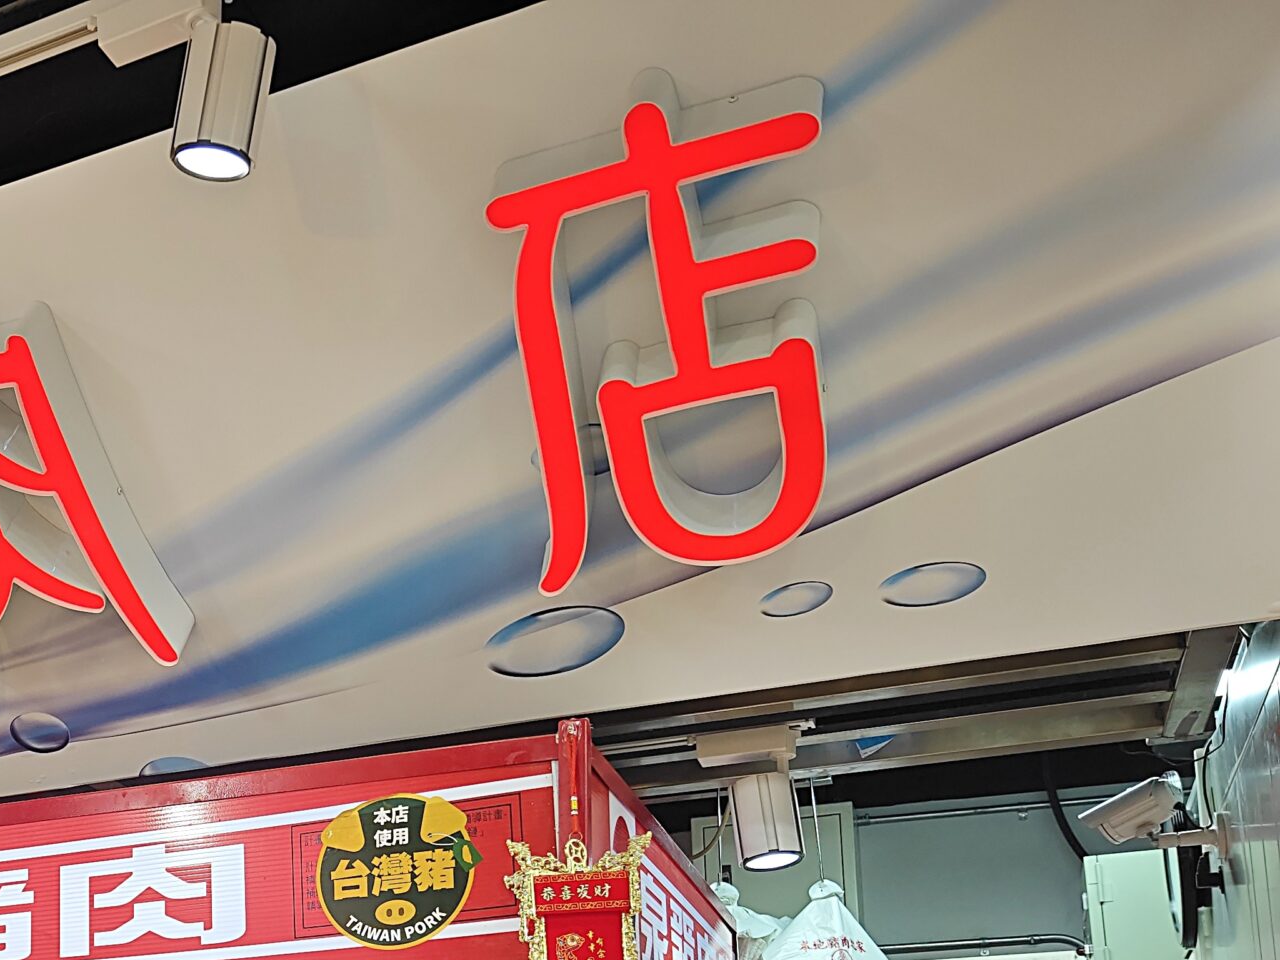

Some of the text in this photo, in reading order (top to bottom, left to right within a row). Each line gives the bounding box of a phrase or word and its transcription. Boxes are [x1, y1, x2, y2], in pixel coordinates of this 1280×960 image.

[373, 805, 409, 826] 本店
[373, 827, 409, 849] 使用
[330, 849, 456, 901] 台灣豬
[345, 906, 448, 943] TAIWAN PORK
